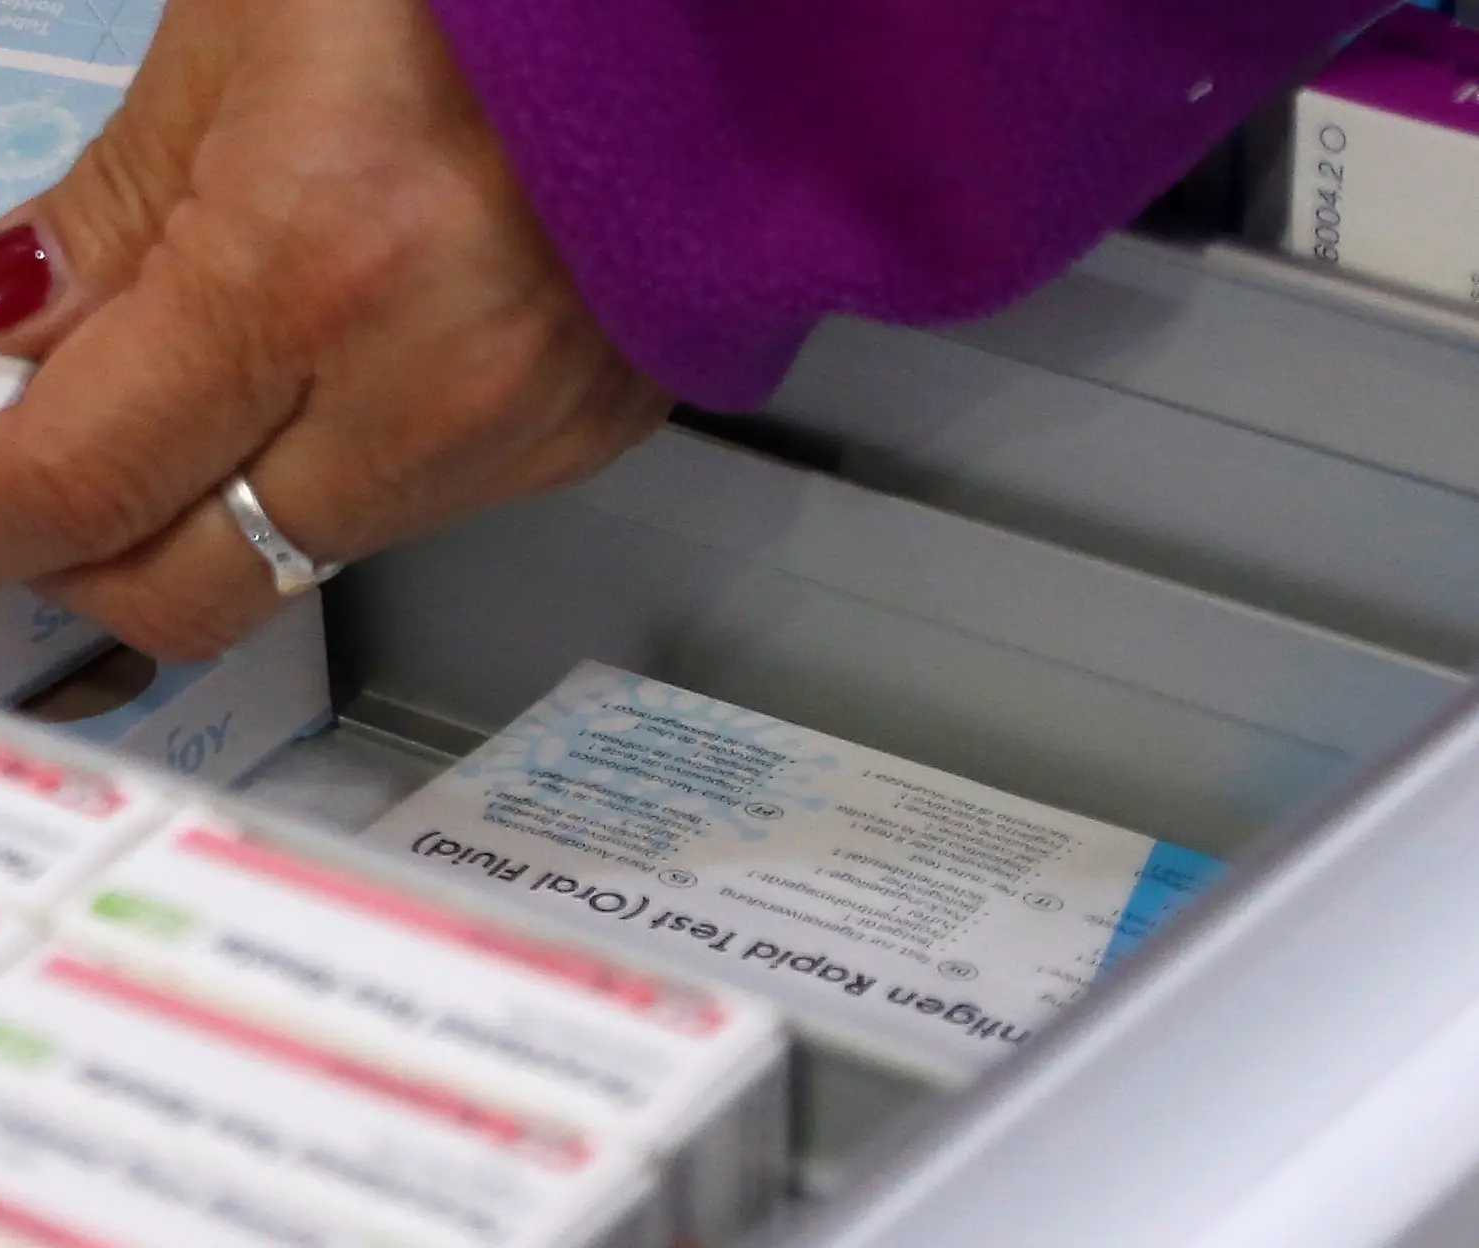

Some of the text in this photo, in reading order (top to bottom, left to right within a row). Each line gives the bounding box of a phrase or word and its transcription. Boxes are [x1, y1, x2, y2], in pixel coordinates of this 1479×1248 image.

[411, 831, 1031, 1045] ntigen Rapid Test (Oral Fluid)
